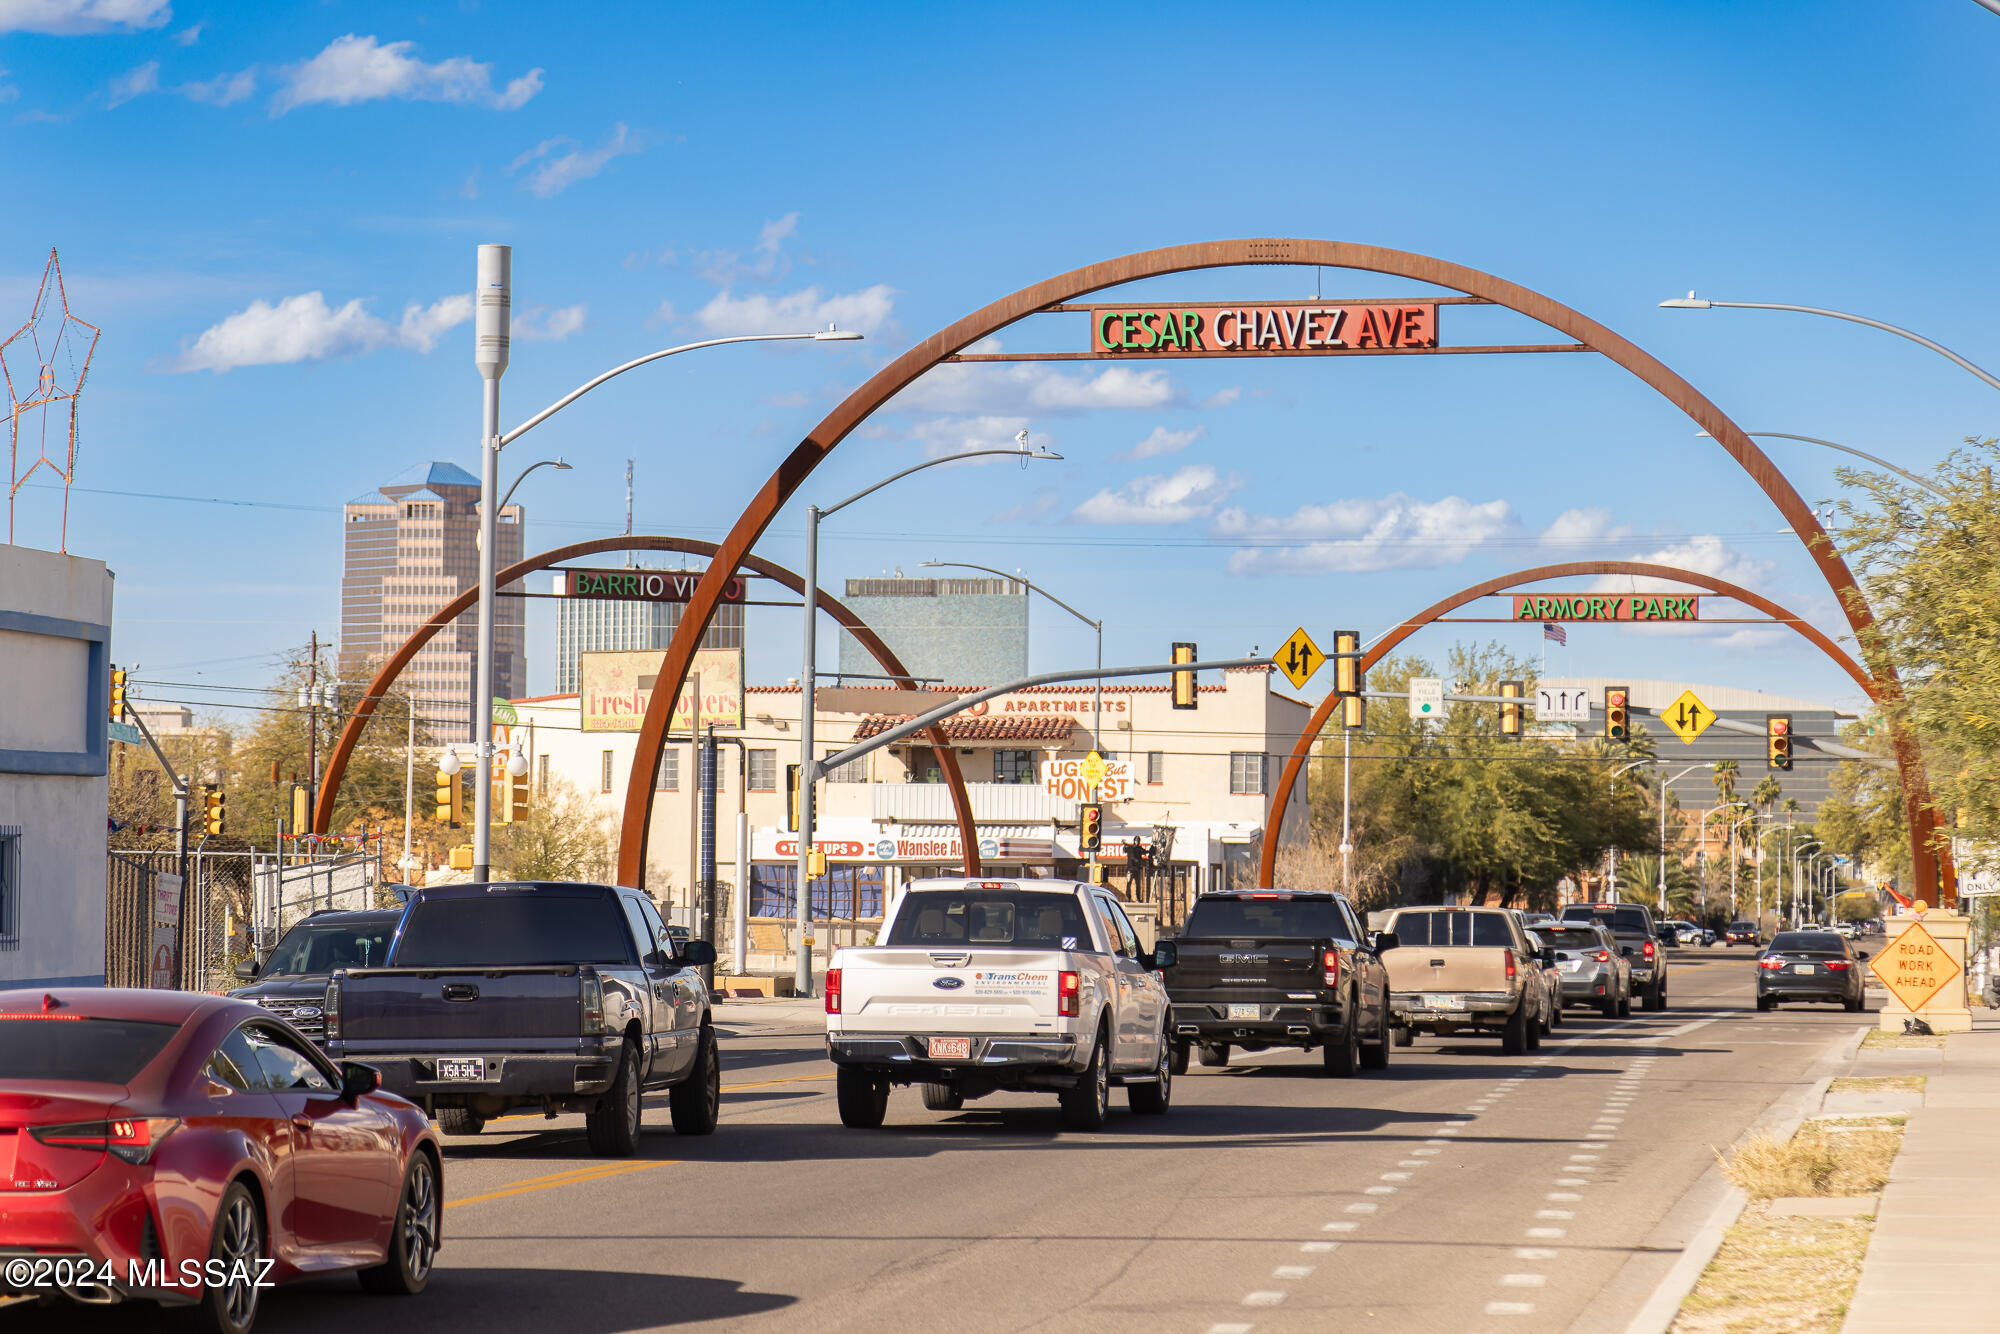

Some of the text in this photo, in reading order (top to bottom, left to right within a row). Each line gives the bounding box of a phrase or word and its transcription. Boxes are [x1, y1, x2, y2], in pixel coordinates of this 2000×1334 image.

[1099, 307, 1431, 349] CESAR CHAVEZ AVE.
[576, 572, 664, 597] BARRIO
[1518, 597, 1694, 618] ARMORY PARK
[590, 688, 646, 715] Fresh
[1104, 762, 1127, 777] But
[823, 843, 848, 854] UPS
[897, 840, 948, 856] Wanslee
[1967, 883, 1995, 891] ONLY
[1900, 944, 1934, 955] ROAD
[1219, 953, 1269, 963] GMC
[1898, 960, 1934, 971] WORK
[986, 973, 1049, 981] TransChem
[1895, 976, 1936, 987] AHEAD
